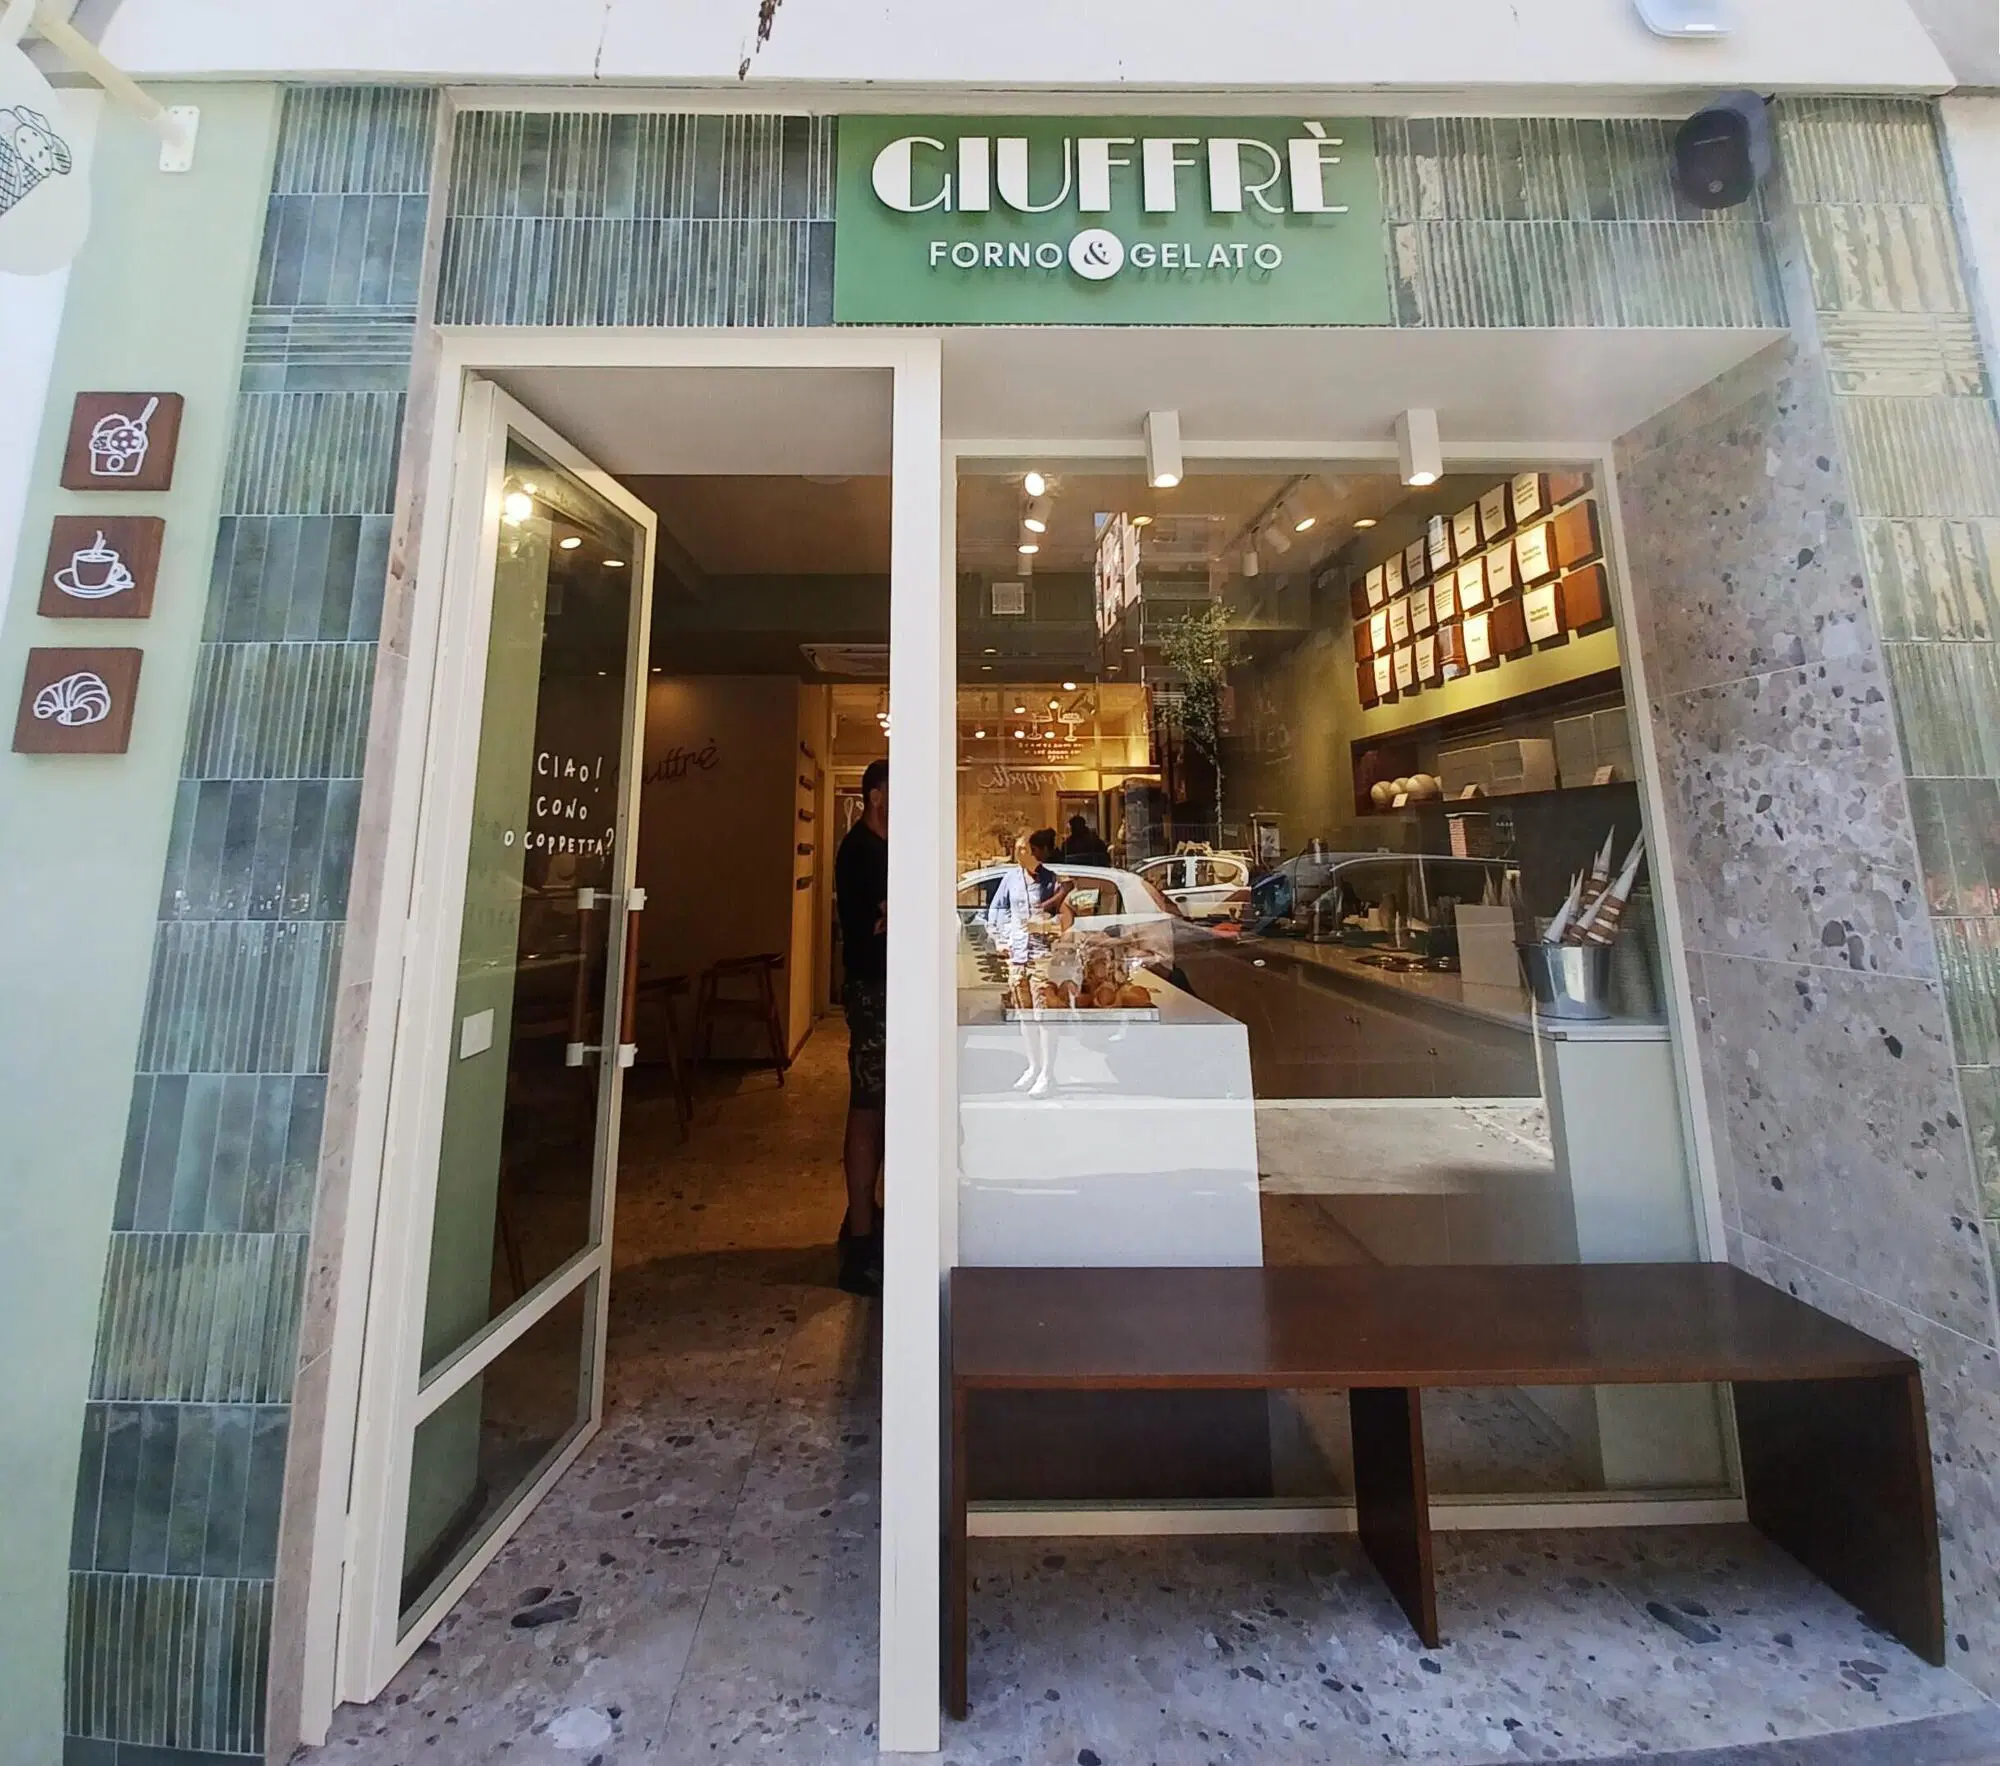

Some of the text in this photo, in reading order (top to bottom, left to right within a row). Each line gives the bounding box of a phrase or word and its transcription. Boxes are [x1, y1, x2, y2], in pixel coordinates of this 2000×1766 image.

[872, 121, 1349, 213] GIUFFRÈ
[929, 240, 1284, 270] FORNO & GELATO
[537, 752, 603, 793] CIAO!
[536, 796, 588, 820] CONO
[503, 826, 614, 855] O COPPETTA?
